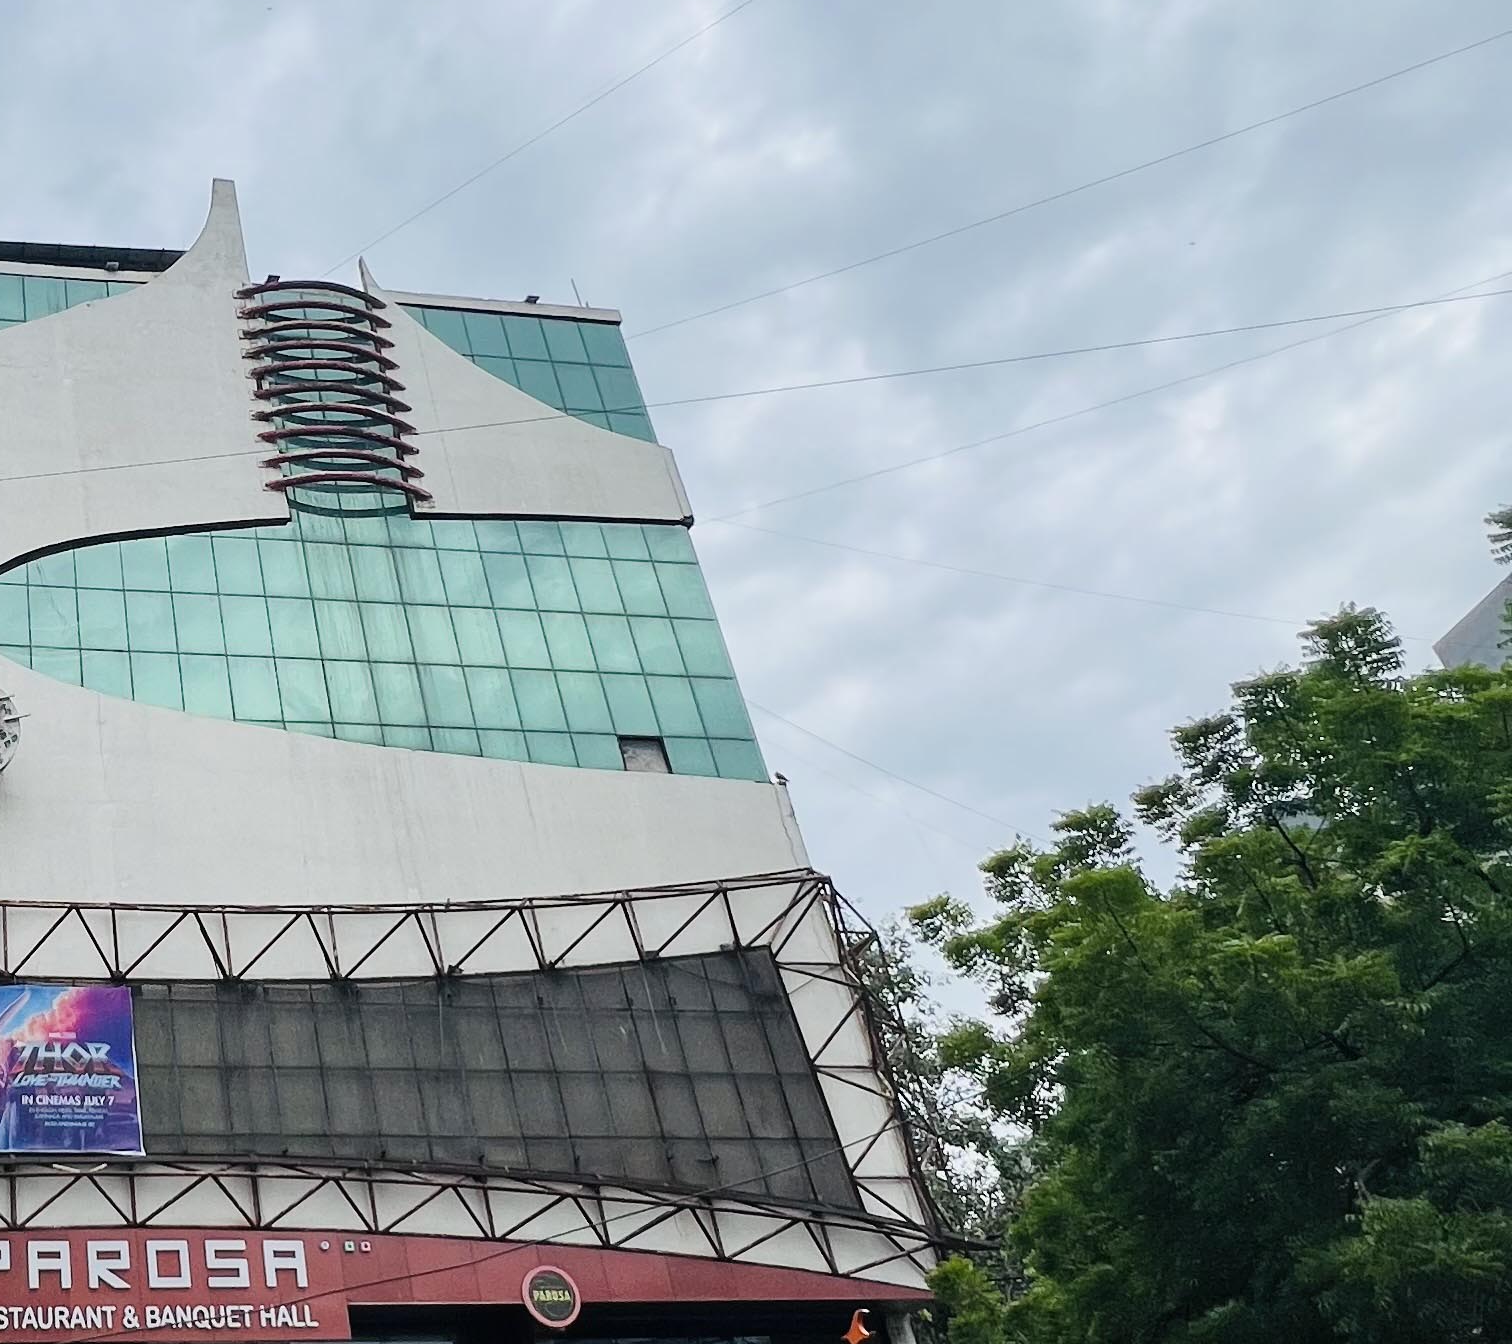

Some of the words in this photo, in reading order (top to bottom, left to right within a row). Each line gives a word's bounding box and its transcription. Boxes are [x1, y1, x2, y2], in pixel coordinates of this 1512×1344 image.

[9, 1040, 122, 1073] THOR
[13, 1072, 49, 1088] LOVE
[50, 1073, 123, 1089] THUNDER
[22, 1095, 34, 1105] IN
[35, 1094, 81, 1106] CINEMAS
[84, 1095, 106, 1106] JULY
[107, 1096, 115, 1106] 7
[532, 1289, 571, 1303] PAROSA
[122, 1306, 140, 1331] &
[145, 1304, 254, 1330] BANQUET
[259, 1304, 320, 1328] HALL
